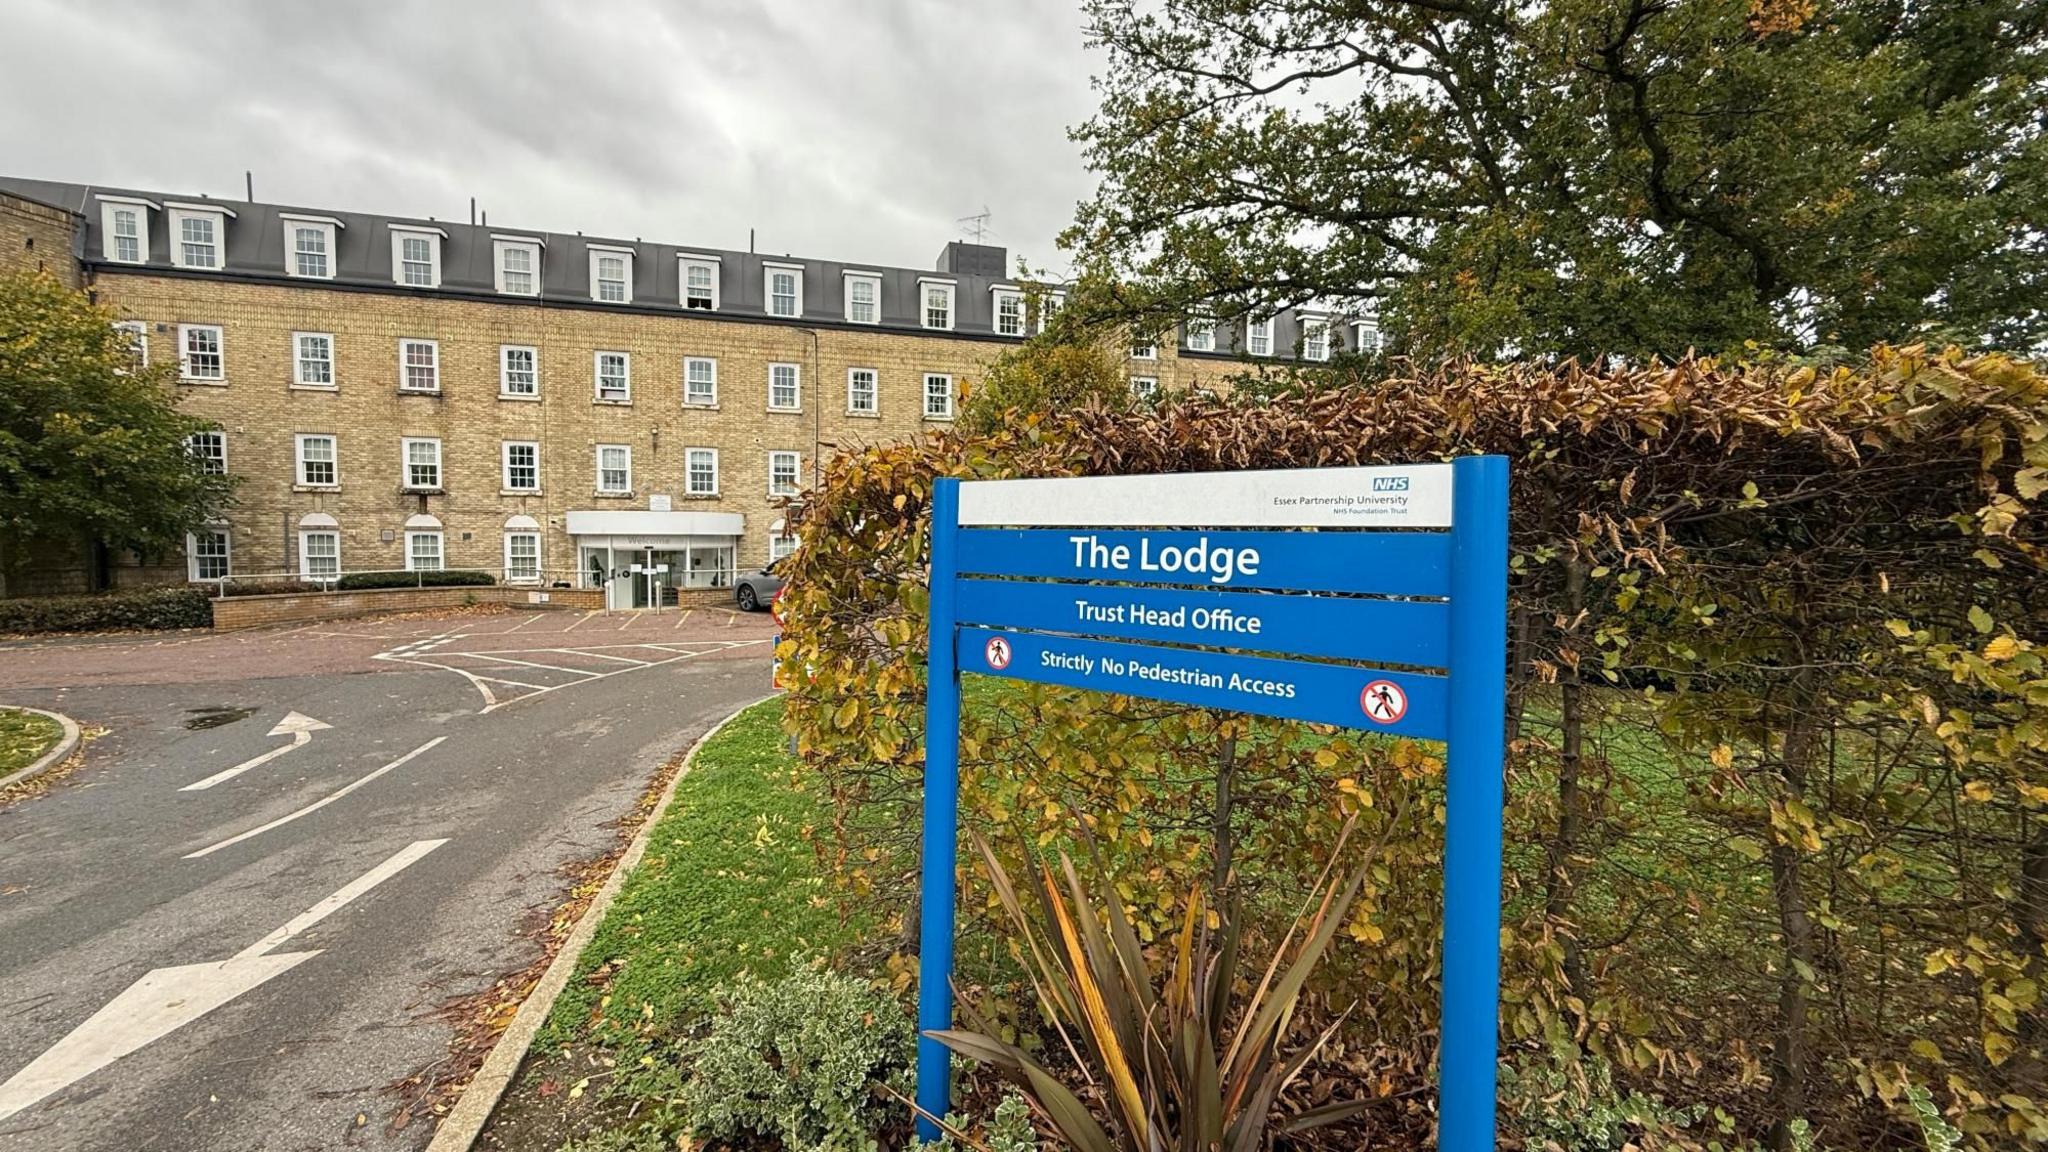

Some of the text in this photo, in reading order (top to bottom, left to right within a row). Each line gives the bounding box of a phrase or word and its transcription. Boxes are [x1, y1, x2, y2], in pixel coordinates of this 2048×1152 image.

[1375, 477, 1408, 491] NHS
[1273, 495, 1409, 507] Essex Partnership University
[627, 535, 671, 544] Welcome
[1069, 536, 1260, 584] The Lodge
[1075, 600, 1261, 634] Trust Head Office
[1041, 650, 1296, 698] Strictly No Pedestrian Access
